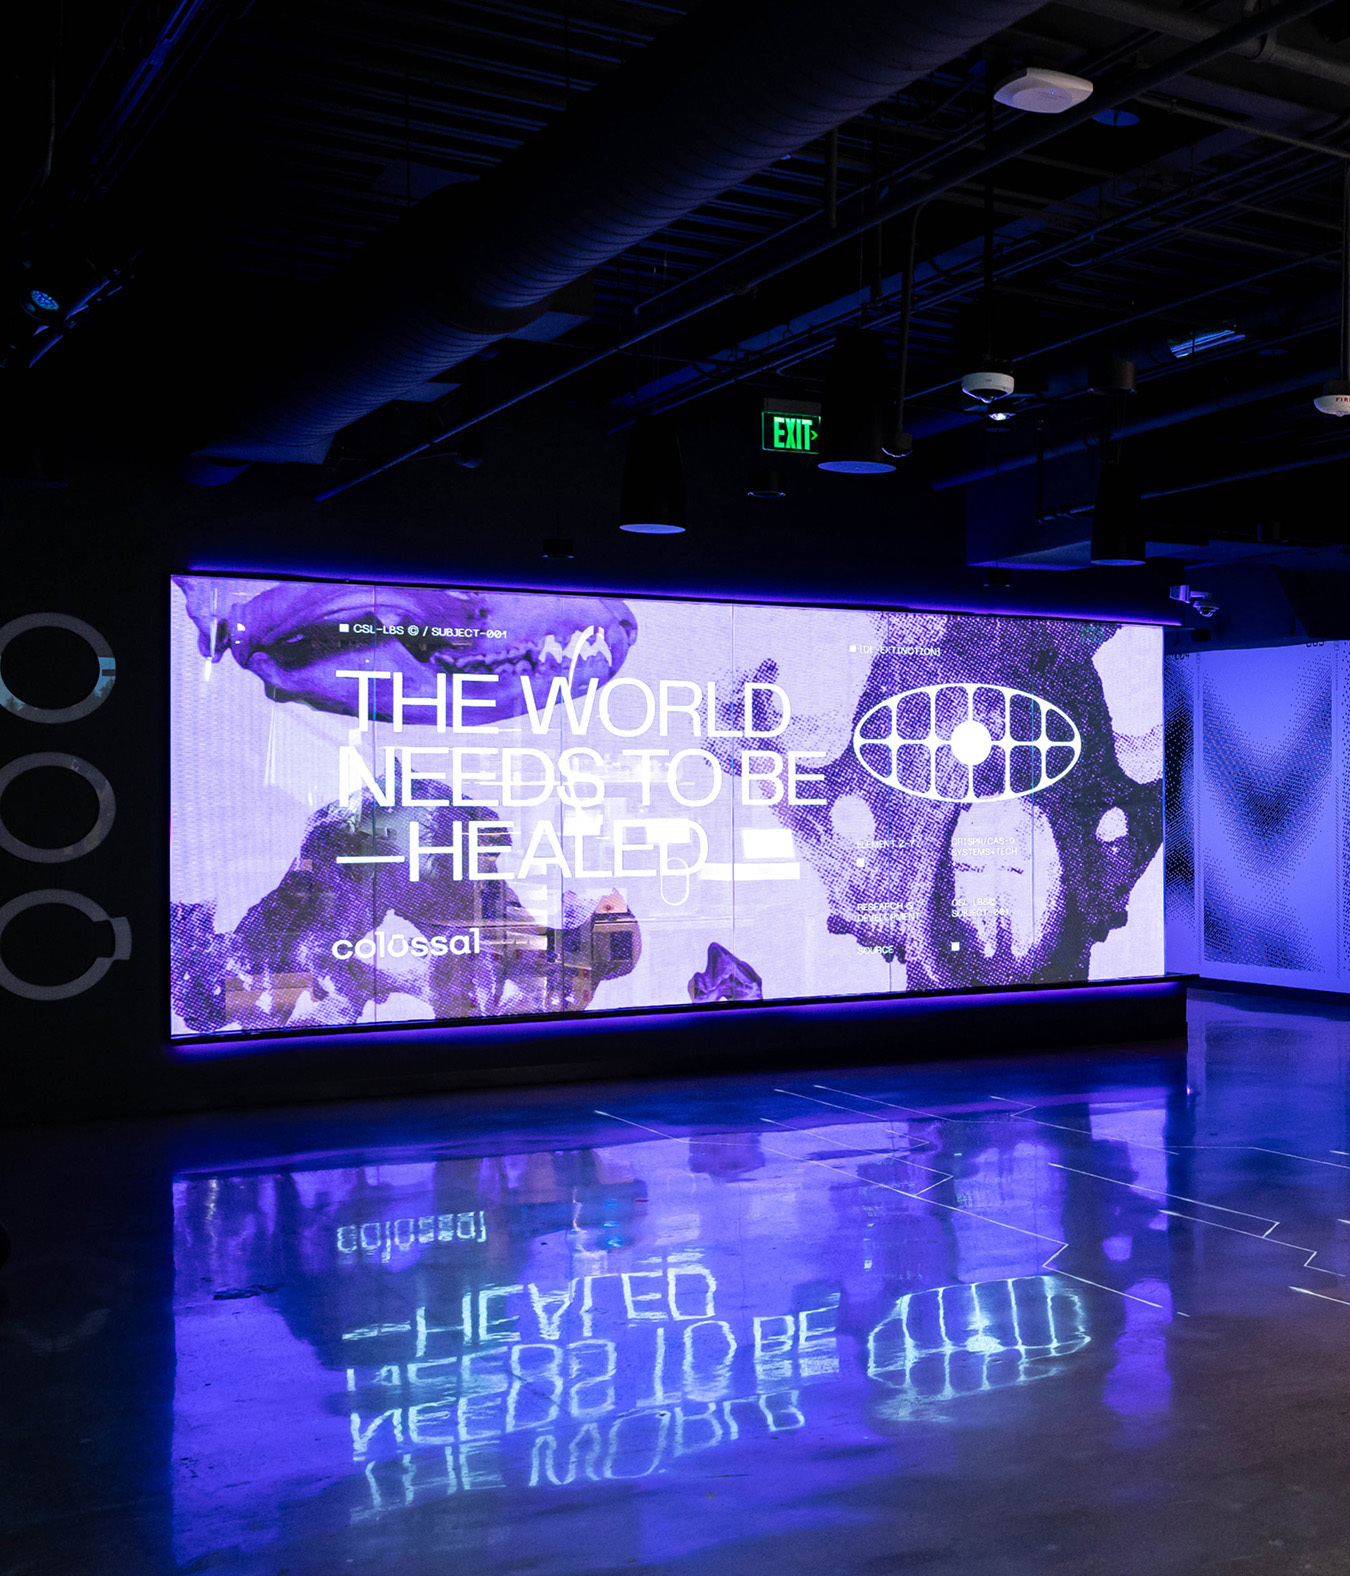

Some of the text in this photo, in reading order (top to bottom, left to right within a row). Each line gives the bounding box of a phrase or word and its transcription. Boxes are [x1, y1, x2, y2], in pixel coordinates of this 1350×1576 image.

[774, 416, 813, 450] EXIT
[353, 624, 404, 635] CSL-LBS
[431, 627, 507, 639] SUBJECT-001
[335, 670, 791, 738] THE WORLD
[339, 745, 827, 809] NEEDS TO BE
